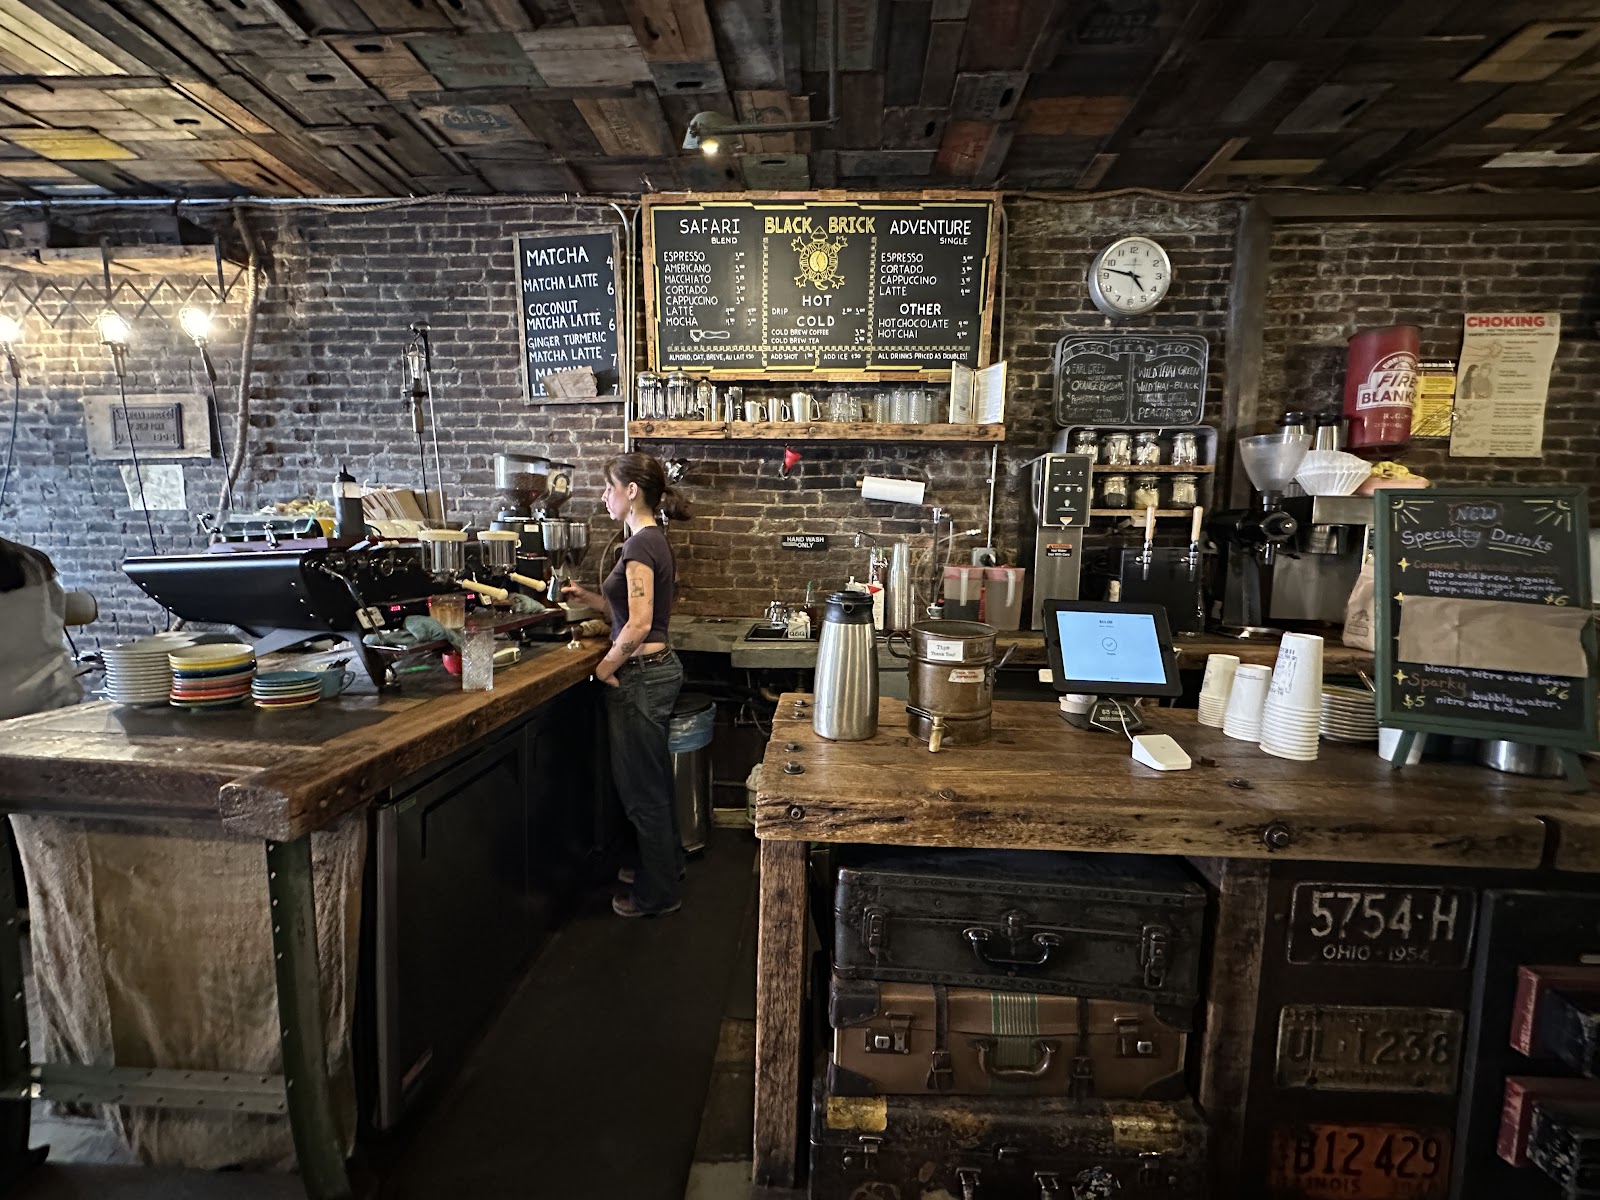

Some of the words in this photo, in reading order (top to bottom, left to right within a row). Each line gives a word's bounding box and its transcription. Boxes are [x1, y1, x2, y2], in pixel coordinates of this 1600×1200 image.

[680, 219, 740, 234] SAFARI
[764, 216, 812, 234] BLACK
[828, 216, 876, 234] BRICK
[890, 220, 972, 235] ADVENTURE
[526, 246, 590, 267] MATCHA
[606, 256, 614, 270] 4
[664, 251, 705, 262] ESPRESSO
[881, 252, 924, 262] ESPRESSO
[664, 264, 711, 273] AMERICANO
[880, 264, 924, 274] CORTADO
[524, 276, 566, 292] MATCHA
[568, 273, 598, 289] LATTE
[606, 282, 614, 296] 6
[664, 274, 711, 284] MACCHIATO
[880, 276, 936, 285] CAPPUCCINO
[666, 286, 708, 294] CORTADO
[879, 286, 907, 296] LATTE
[666, 296, 718, 306] CAPPUCCINO
[802, 295, 832, 306] HOT
[528, 300, 578, 316] COCONUT
[666, 306, 694, 316] LATTE
[900, 304, 942, 316] OTHER
[526, 316, 569, 330] MATCHA
[570, 312, 602, 327] LATTE
[608, 318, 616, 331] 6
[666, 317, 698, 326] MOCHA
[796, 316, 835, 326] COLD
[878, 318, 896, 328] HOT
[898, 318, 949, 328] CHOCOLATE
[1466, 316, 1546, 328] CHOKING
[878, 330, 896, 338] HOT
[897, 330, 918, 338] CHAI
[528, 335, 560, 350] GINGER
[563, 331, 606, 346] TURMERIC
[530, 349, 568, 362] MATCHA
[570, 346, 602, 360] LATTE
[610, 354, 617, 366] 7
[1138, 367, 1158, 378] WILD
[1158, 362, 1176, 378] THAI
[1178, 365, 1199, 376] GREEN
[612, 384, 618, 396] 7
[1072, 380, 1100, 391] ORANGE
[1136, 382, 1153, 392] WILD
[1456, 506, 1498, 520] NEW
[1402, 527, 1481, 548] Specialty
[1492, 528, 1553, 552] Drinks
[1414, 560, 1460, 570] Coconut
[1428, 570, 1454, 578] nitro
[1458, 572, 1478, 580] cold
[1515, 576, 1554, 586] organic
[1486, 582, 1516, 592] sugar
[1464, 586, 1484, 594] milk
[1487, 588, 1498, 596] of
[1504, 590, 1538, 600] choice
[1543, 592, 1570, 606] $6
[1472, 670, 1504, 680] nitro
[1508, 674, 1532, 684] cold
[1537, 677, 1570, 688] brew
[1407, 673, 1467, 698] Sparky
[1472, 691, 1513, 706] bubbly
[1545, 687, 1568, 700] $6
[1402, 694, 1426, 709] $5
[1436, 696, 1464, 706] nitro
[1467, 700, 1490, 710] cold
[1322, 944, 1370, 960] OHIO
